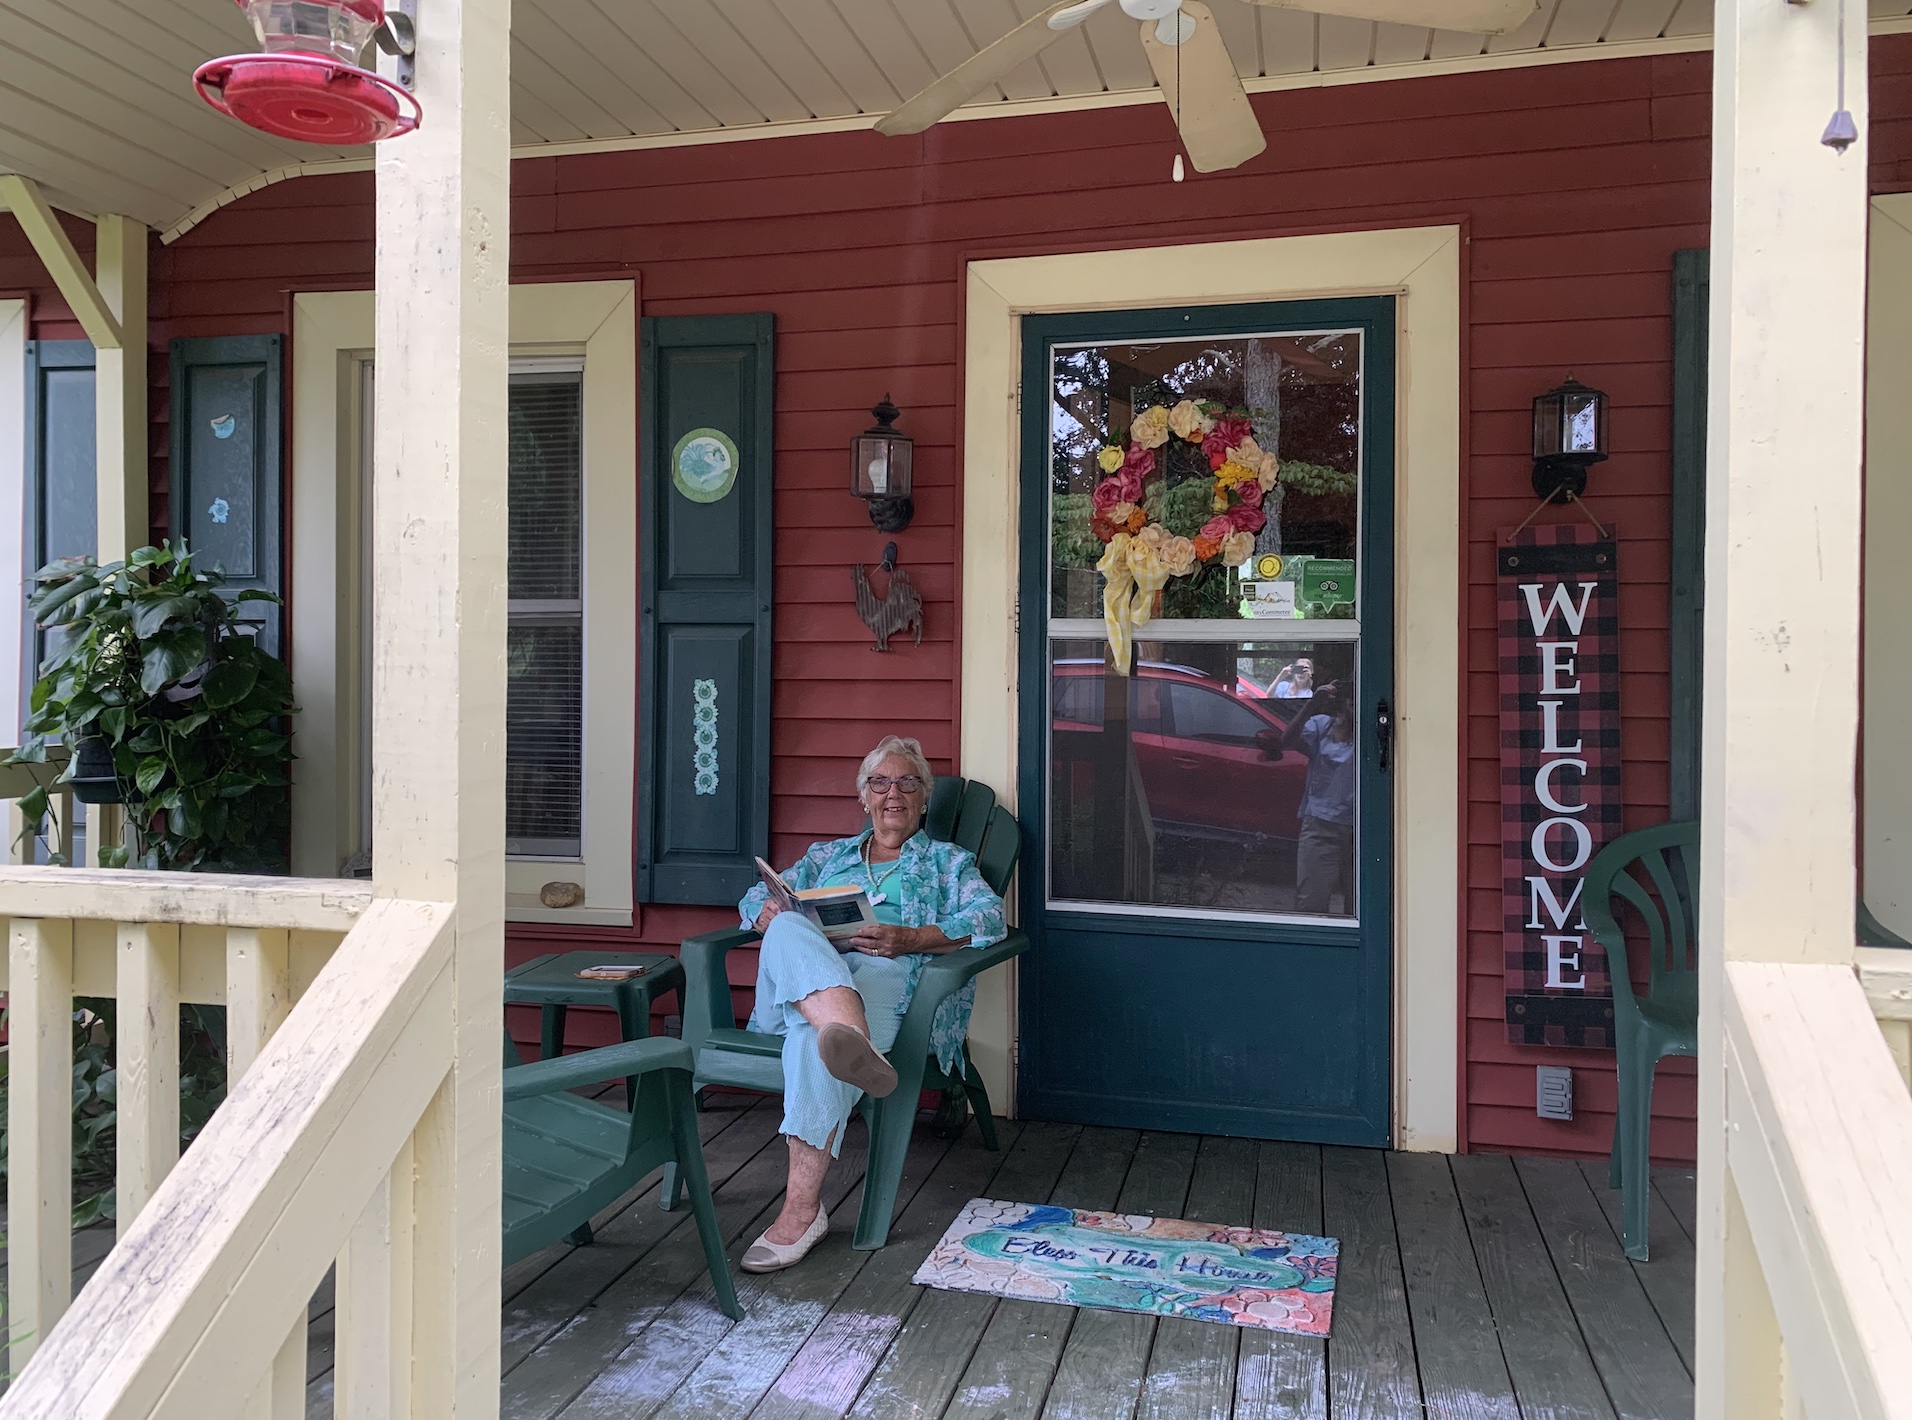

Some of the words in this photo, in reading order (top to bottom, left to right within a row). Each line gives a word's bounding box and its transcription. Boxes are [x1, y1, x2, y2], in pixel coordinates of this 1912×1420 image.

[1518, 582, 1598, 989] WELCOME
[1001, 1237, 1077, 1261] Bless
[1089, 1247, 1158, 1269] This
